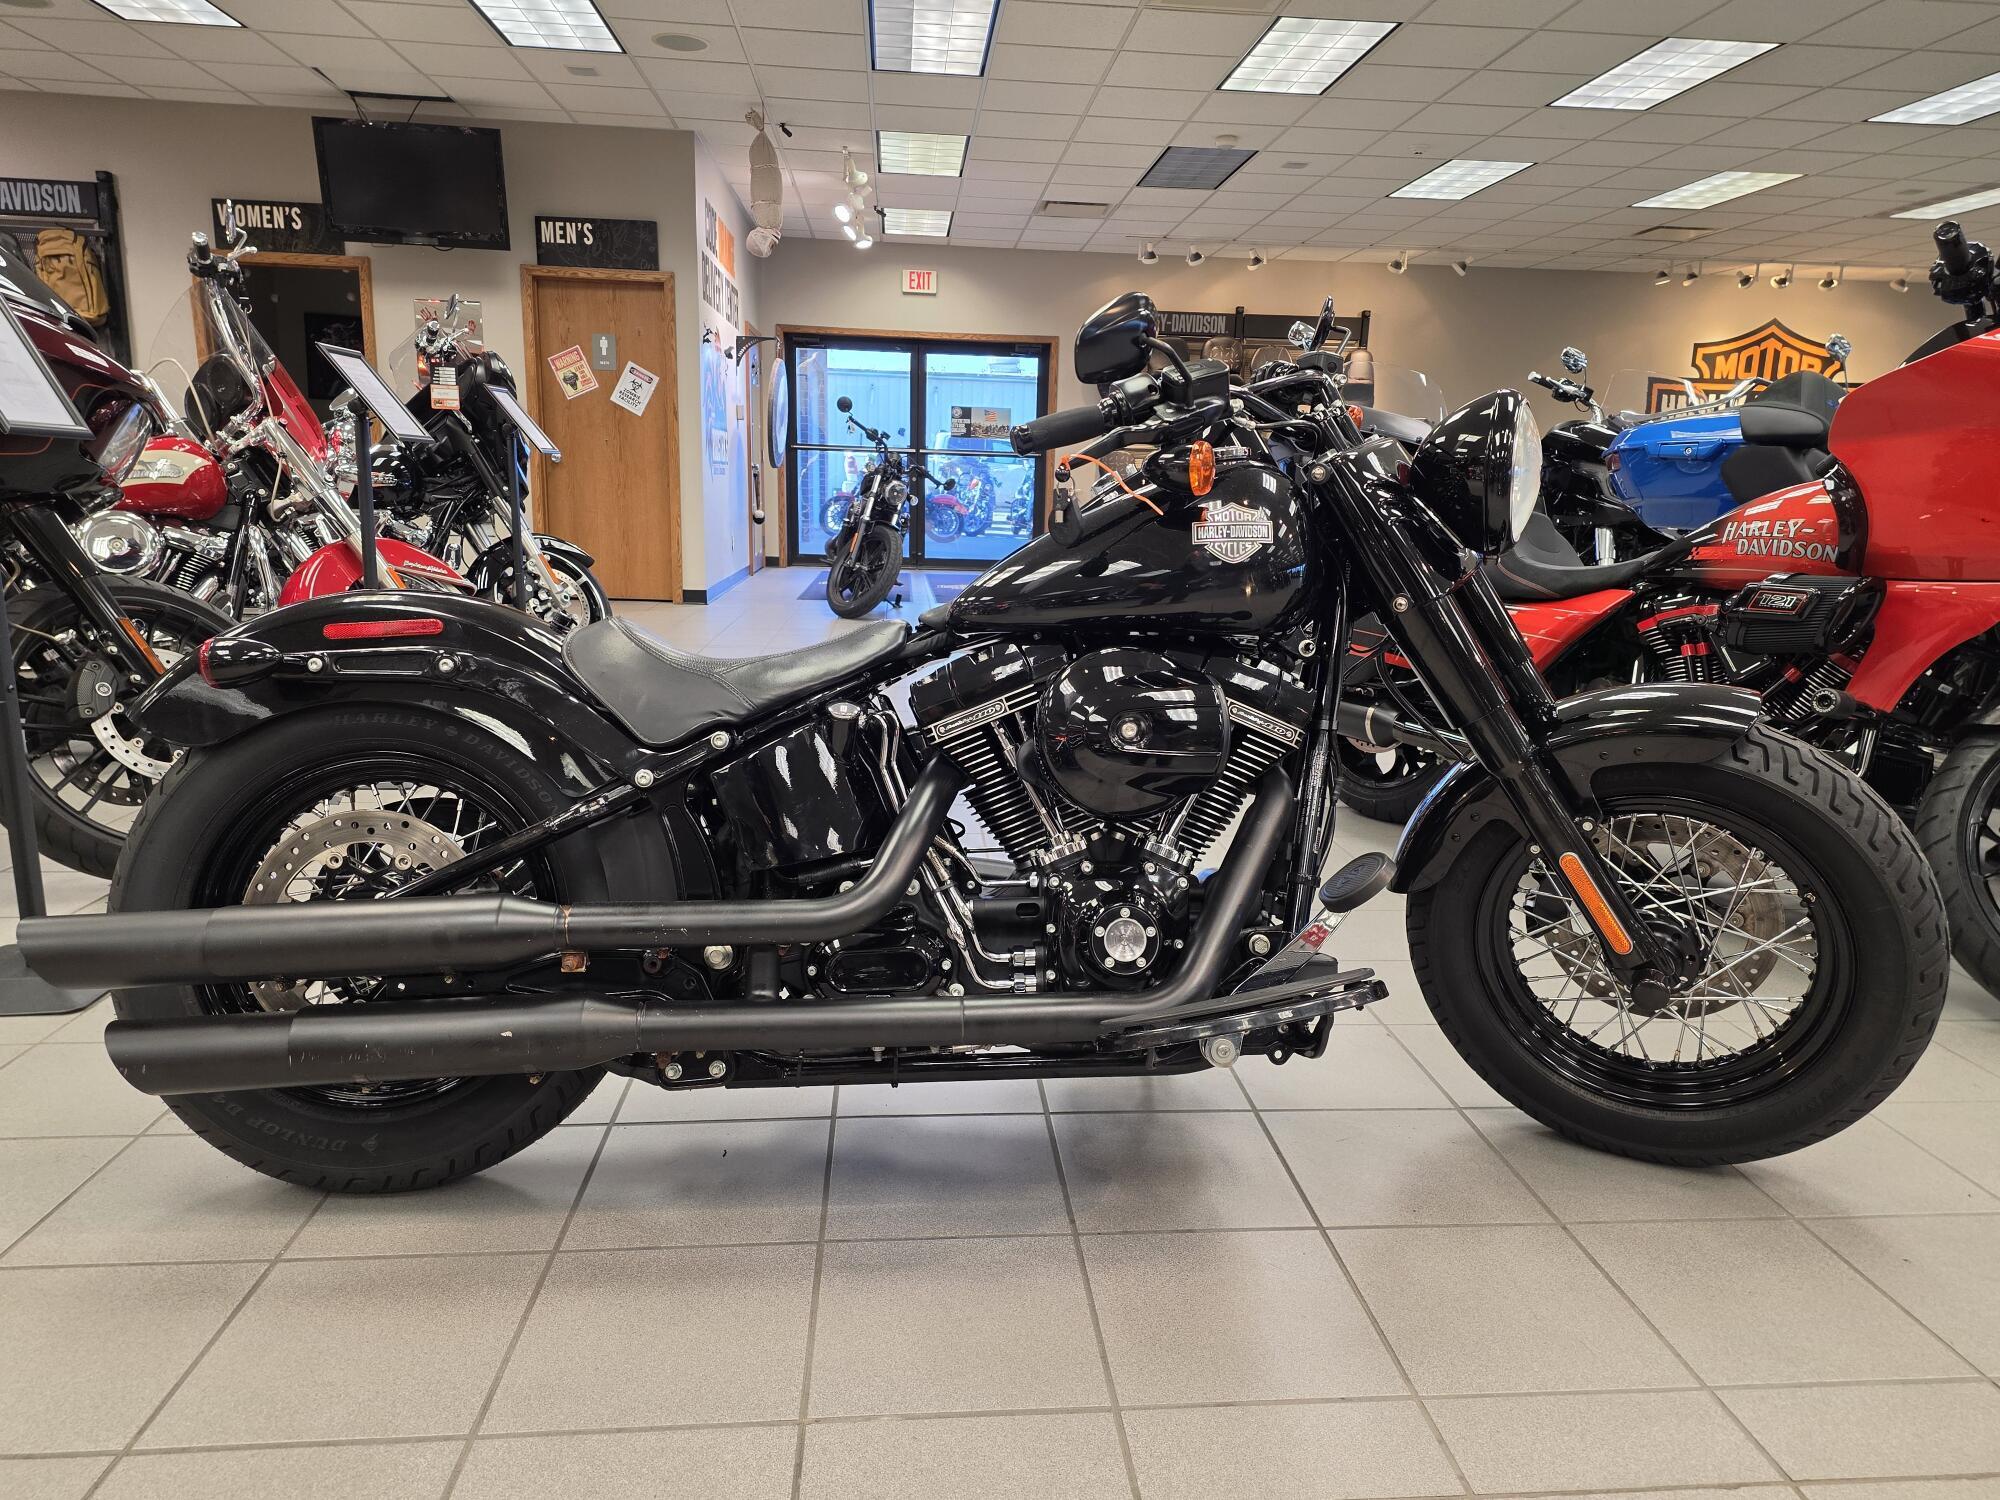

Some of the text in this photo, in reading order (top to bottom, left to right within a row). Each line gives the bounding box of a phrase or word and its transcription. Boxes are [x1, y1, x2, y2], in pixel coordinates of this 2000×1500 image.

[541, 220, 594, 245] MEN'S
[910, 271, 932, 290] EXIT
[618, 395, 638, 408] FACILITY
[619, 391, 642, 405] RESEARCH
[1214, 508, 1252, 521] MOTOR
[1198, 525, 1268, 539] HARLEY-DAVIDSON
[1722, 519, 1815, 544] HARLEY-
[1214, 542, 1252, 558] CYCLES
[1736, 538, 1839, 563] DAVIDSON
[1760, 593, 1797, 607] 121
[335, 712, 438, 730] HARLEY
